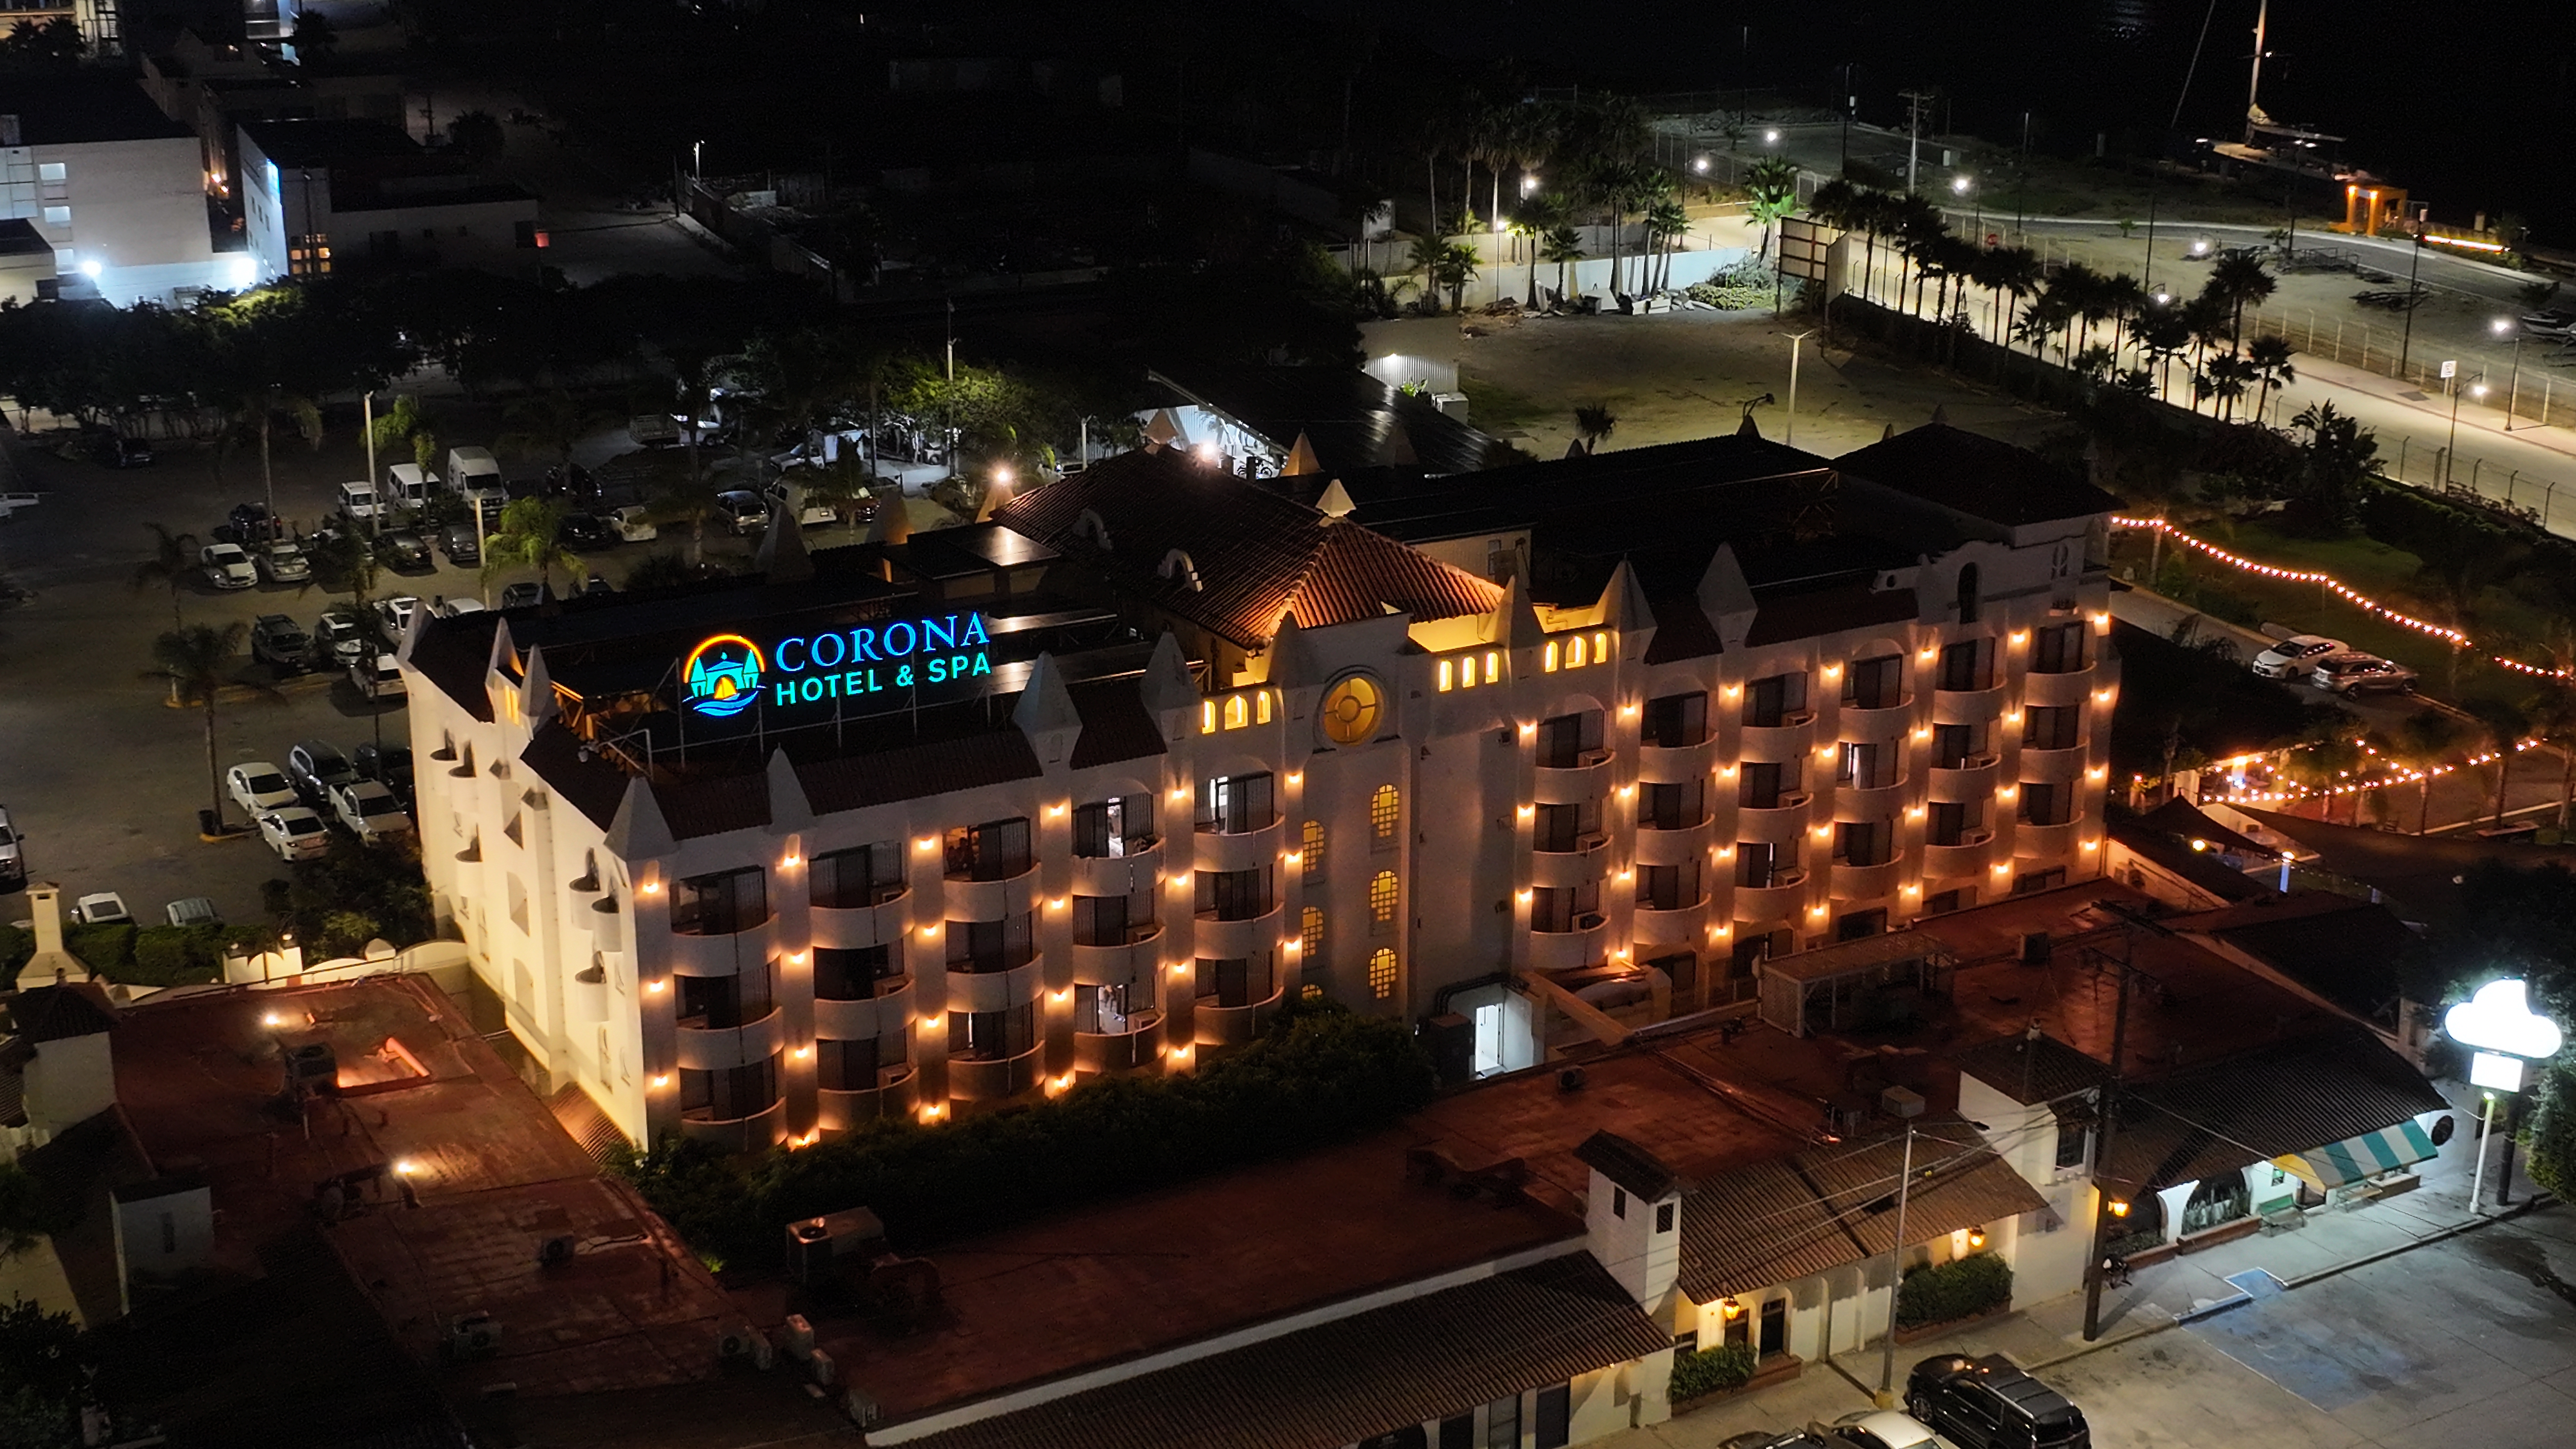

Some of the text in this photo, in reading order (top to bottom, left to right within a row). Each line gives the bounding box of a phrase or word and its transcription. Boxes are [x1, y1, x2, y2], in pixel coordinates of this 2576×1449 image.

[776, 612, 989, 671] CORONA
[776, 652, 991, 706] HOTEL & SPA
